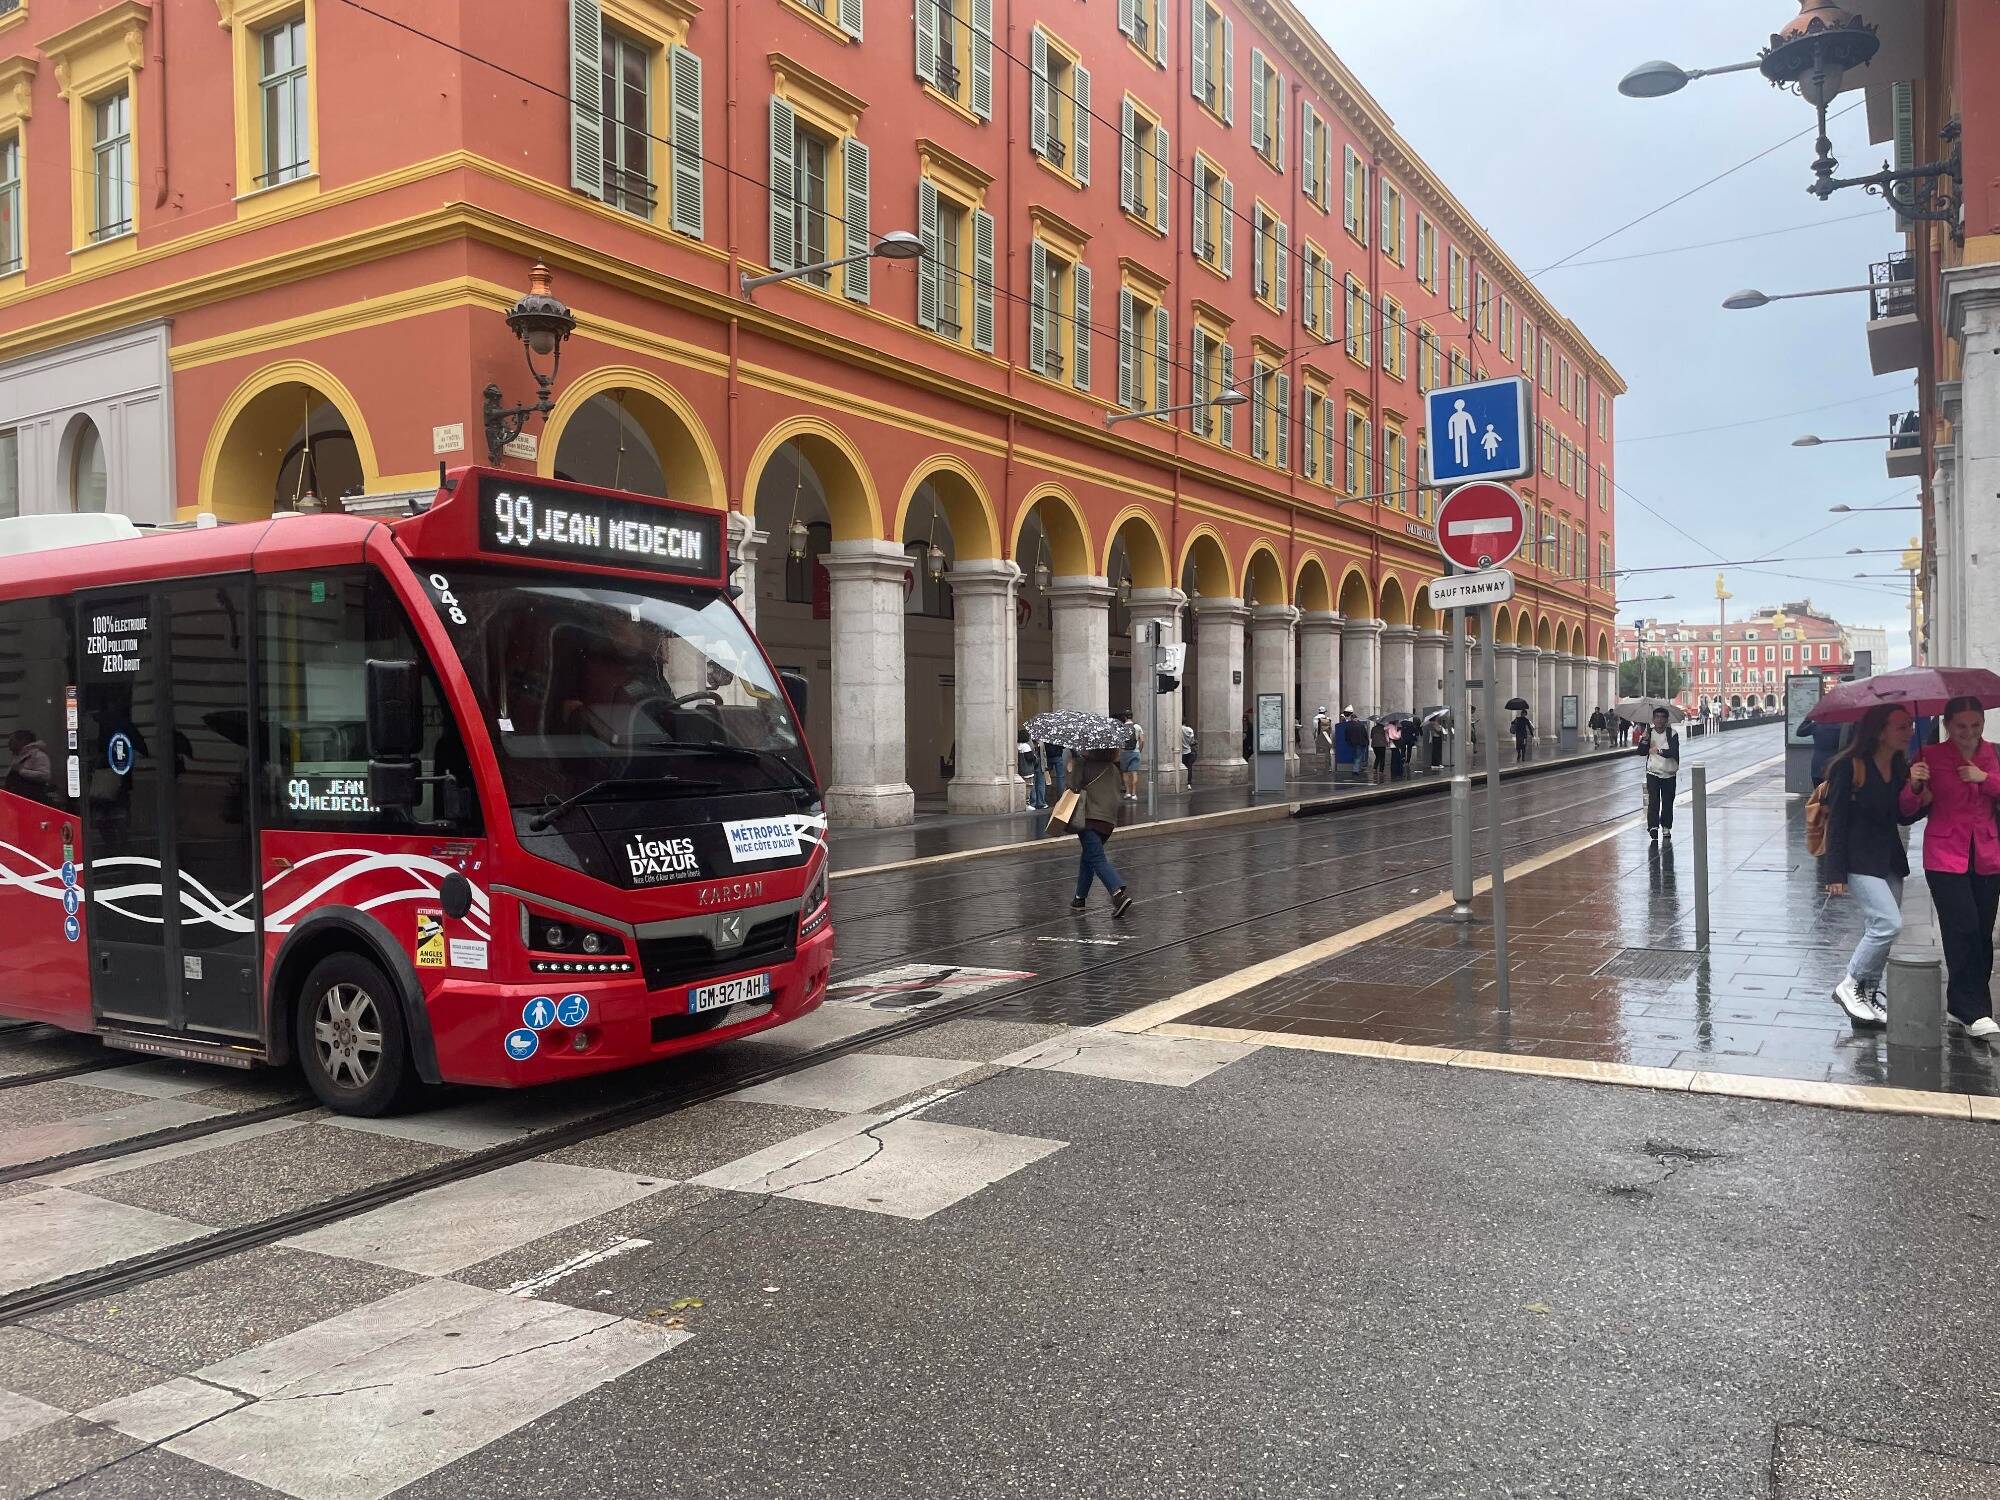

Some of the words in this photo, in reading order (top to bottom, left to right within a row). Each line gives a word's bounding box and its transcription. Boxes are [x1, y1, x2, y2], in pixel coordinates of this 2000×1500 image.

[495, 493, 534, 546] 99
[536, 509, 600, 547] JEAN
[608, 519, 702, 560] MEDECIN
[430, 574, 467, 625] 048
[1434, 587, 1457, 599] SAUF
[1460, 581, 1505, 596] TRAMWAY
[93, 615, 114, 634] 100%
[88, 636, 107, 654] ZERO
[103, 654, 123, 672] ZERO
[288, 779, 310, 810] 99
[325, 779, 366, 795] JEAN
[730, 823, 793, 842] MÉTROPOLE
[625, 834, 695, 860] LIGNES
[735, 842, 753, 854] NICE
[753, 839, 772, 852] CÔTE
[772, 838, 796, 850] D'AZUR
[630, 853, 700, 877] D'AZUR
[699, 881, 763, 906] KARSAN
[419, 950, 443, 958] ANGLES
